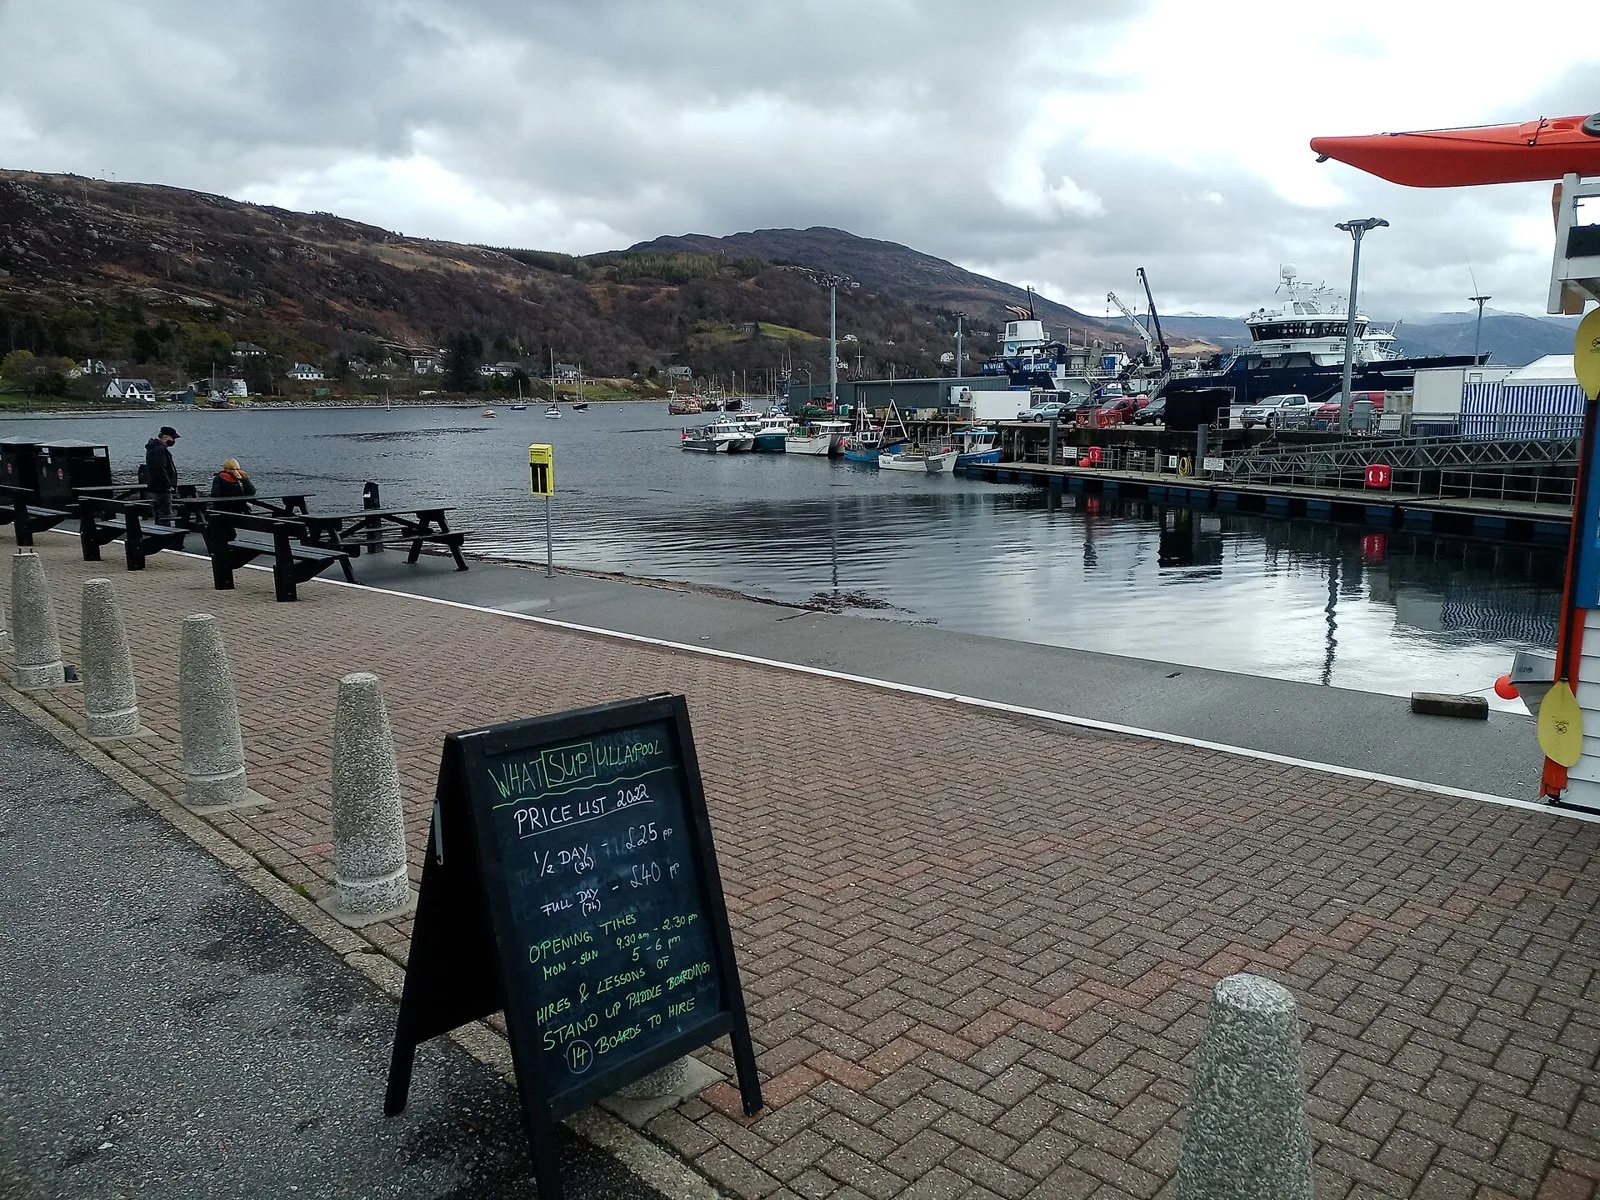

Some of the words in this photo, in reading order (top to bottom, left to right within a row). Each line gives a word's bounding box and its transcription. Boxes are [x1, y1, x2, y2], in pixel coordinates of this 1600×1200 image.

[488, 759, 542, 798] WHAT
[549, 752, 588, 783] SUP
[596, 740, 663, 766] ULLAPOOL
[513, 804, 573, 835] PRICE
[578, 796, 607, 816] LIST
[616, 783, 650, 808] 2022
[557, 843, 589, 865] DAY
[625, 822, 658, 850] £25
[574, 856, 595, 875] (3h)
[540, 899, 573, 916] FULL
[576, 888, 599, 904] DAY
[630, 861, 661, 888] £40
[581, 899, 602, 917] (7h)
[529, 931, 593, 964] OPENING
[599, 913, 637, 936] TIMES
[542, 963, 566, 981] MON
[579, 949, 599, 965] SUN
[616, 933, 636, 950] 9.30
[662, 915, 686, 931] 2.30
[631, 946, 640, 962] 5
[655, 938, 663, 951] 6
[536, 997, 571, 1026] HIRES
[597, 967, 646, 995] LESSONS
[656, 955, 670, 970] OF
[543, 1013, 598, 1051] STAND
[605, 1001, 621, 1019] UP
[625, 984, 662, 1010] PADDLE
[666, 961, 711, 991] BOARDING
[571, 1045, 589, 1069] 14
[594, 1023, 641, 1054] BOARDS
[647, 1013, 662, 1030] TO
[668, 997, 696, 1019] HIRE
